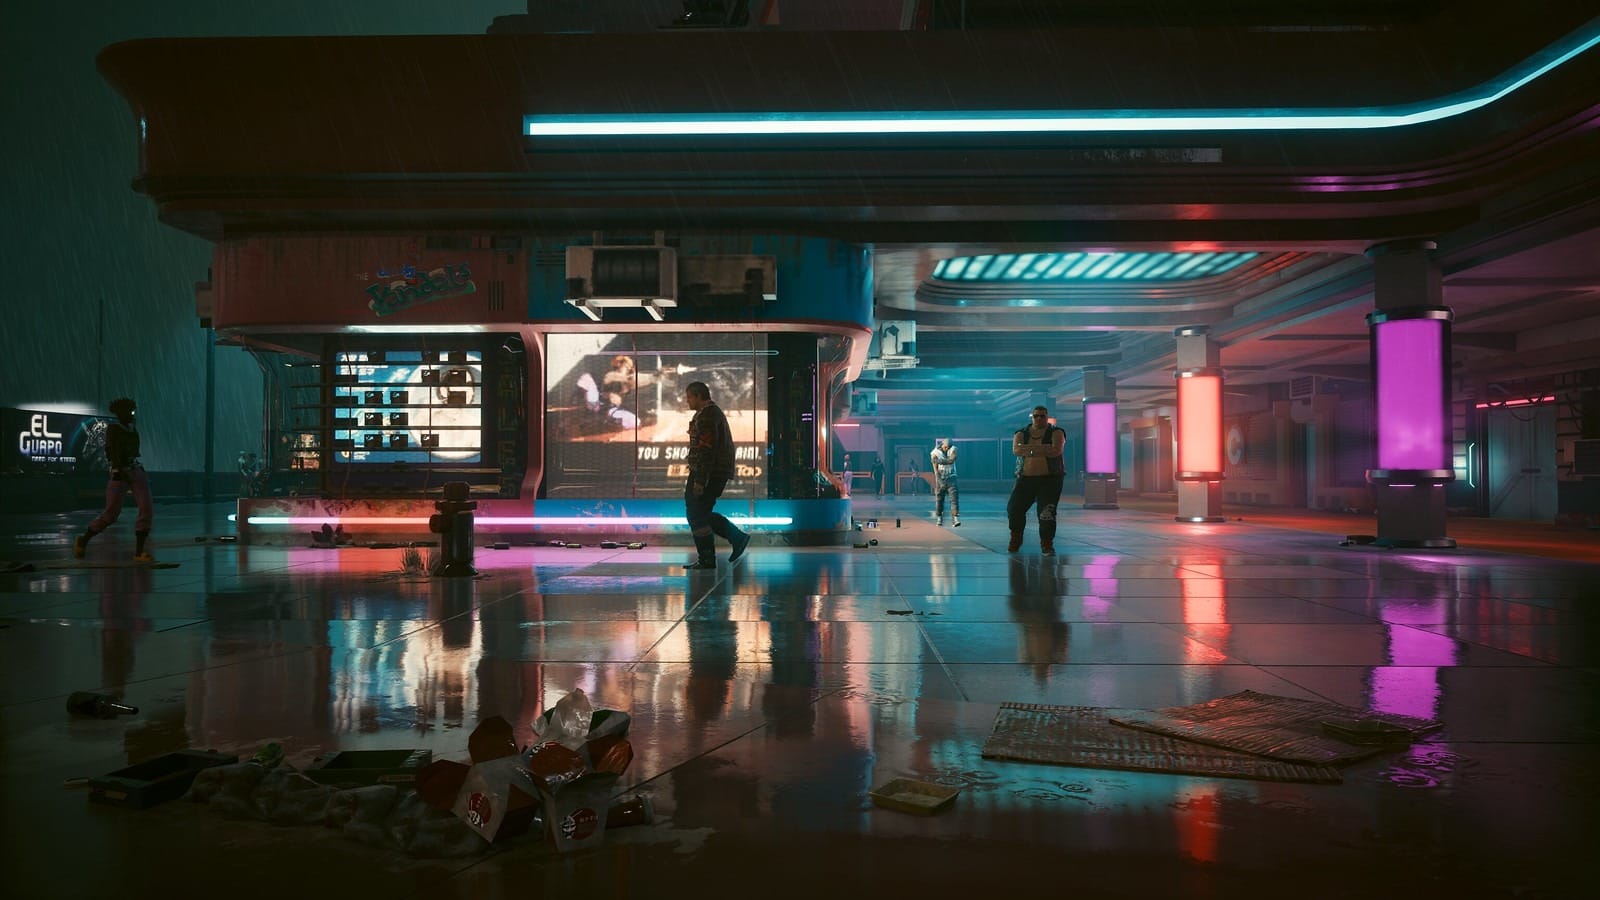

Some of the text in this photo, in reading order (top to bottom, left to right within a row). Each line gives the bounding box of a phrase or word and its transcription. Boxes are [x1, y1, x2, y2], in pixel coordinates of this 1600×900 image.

[31, 414, 62, 438] EL
[19, 431, 62, 455] GUAPO
[638, 446, 660, 460] YOU
[665, 446, 691, 460] SHO
